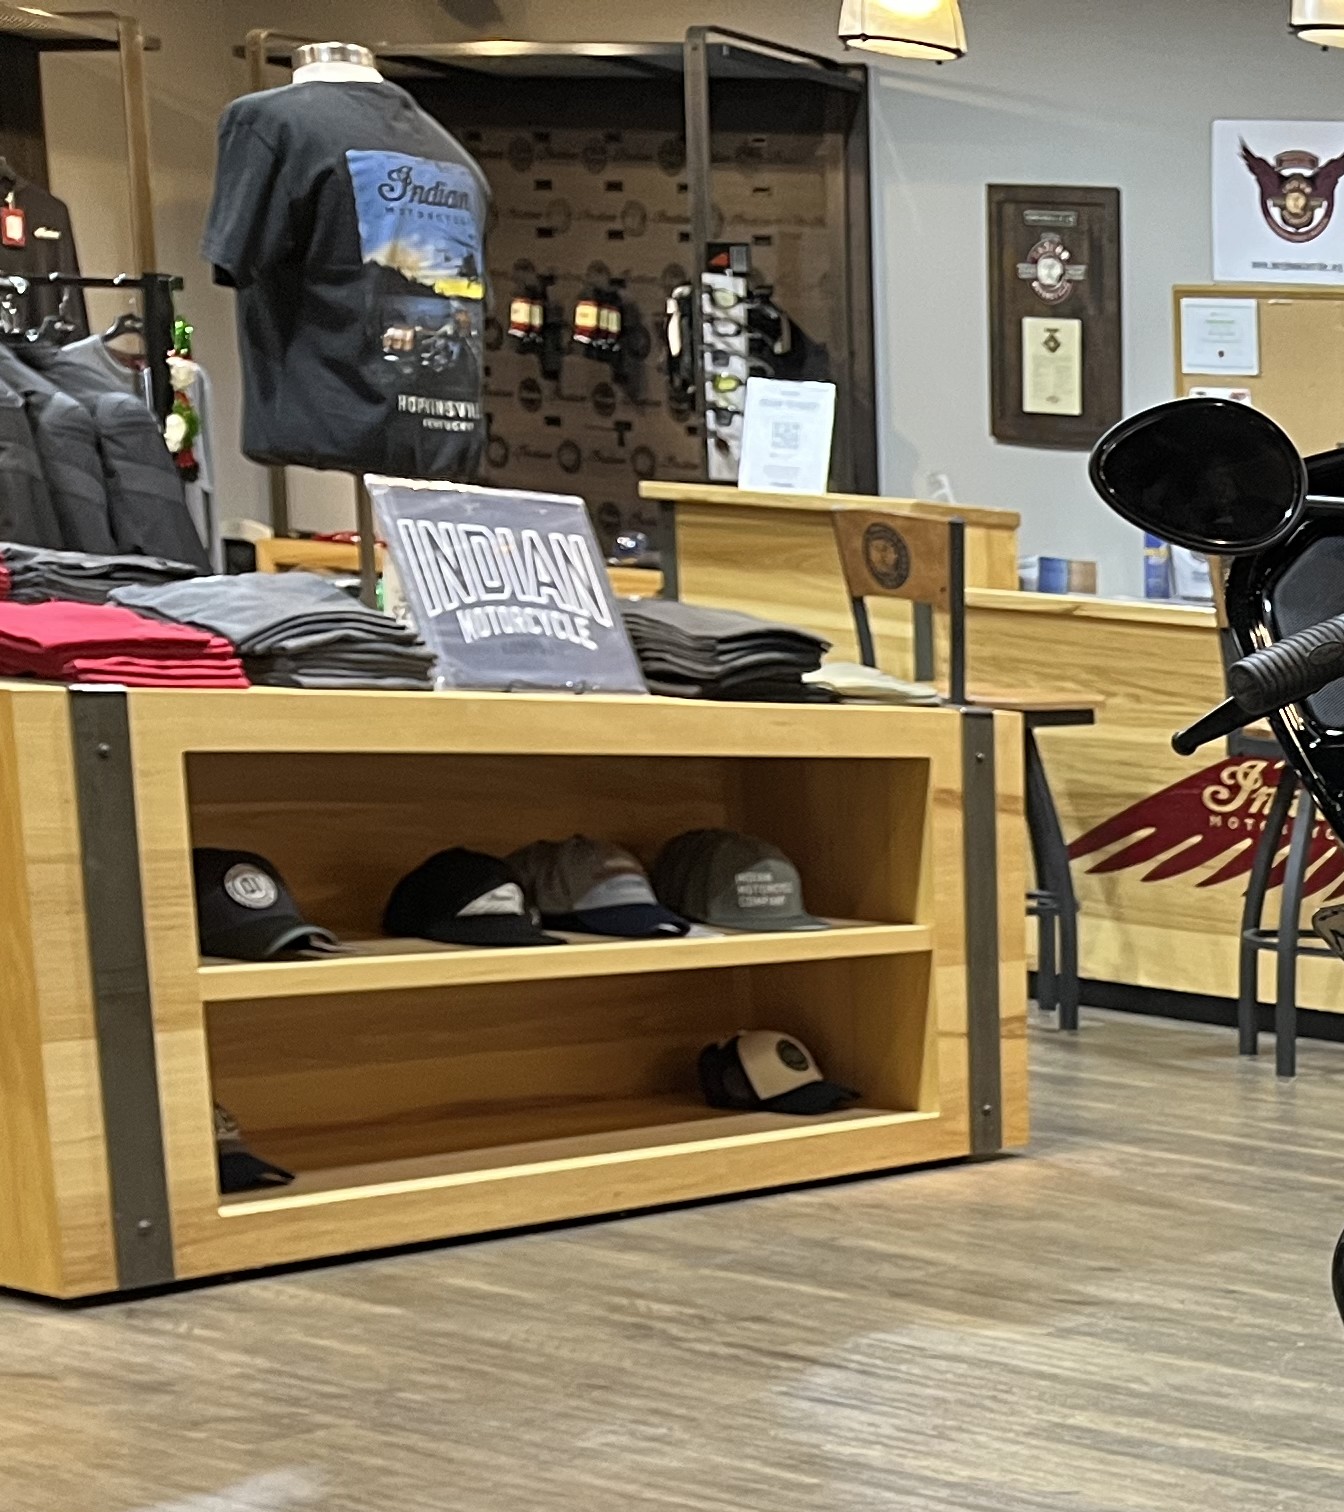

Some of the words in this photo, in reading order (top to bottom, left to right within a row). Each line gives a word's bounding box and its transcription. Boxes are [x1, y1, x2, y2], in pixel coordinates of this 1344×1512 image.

[378, 166, 470, 209] Indian
[397, 519, 614, 628] INDIAN
[456, 606, 599, 651] MOTORCYCLE
